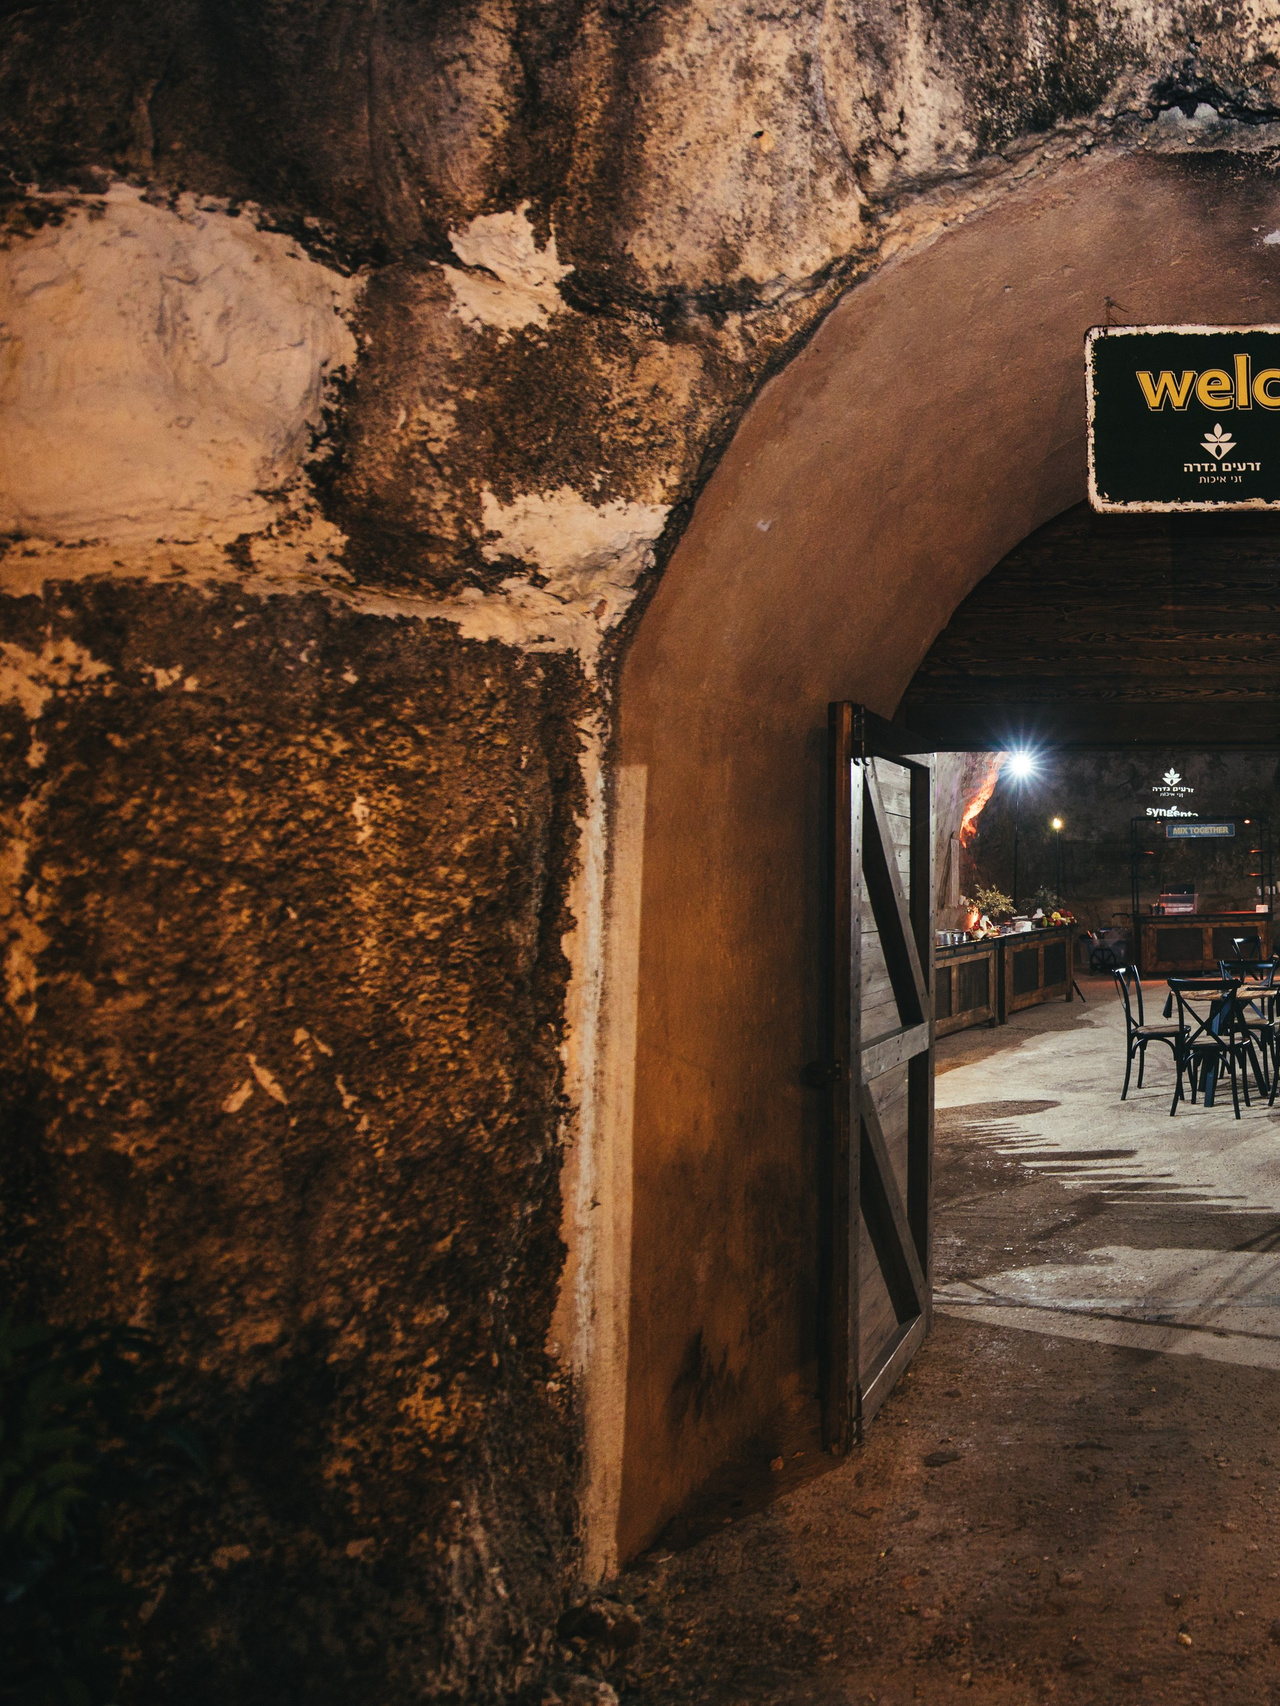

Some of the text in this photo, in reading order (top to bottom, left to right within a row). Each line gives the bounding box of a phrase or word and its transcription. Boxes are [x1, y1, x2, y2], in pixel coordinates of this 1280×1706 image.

[1183, 462, 1262, 473] זרעים גדרה
[1198, 475, 1243, 484] זני איכות
[1172, 826, 1229, 835] MIX TOGETHER
